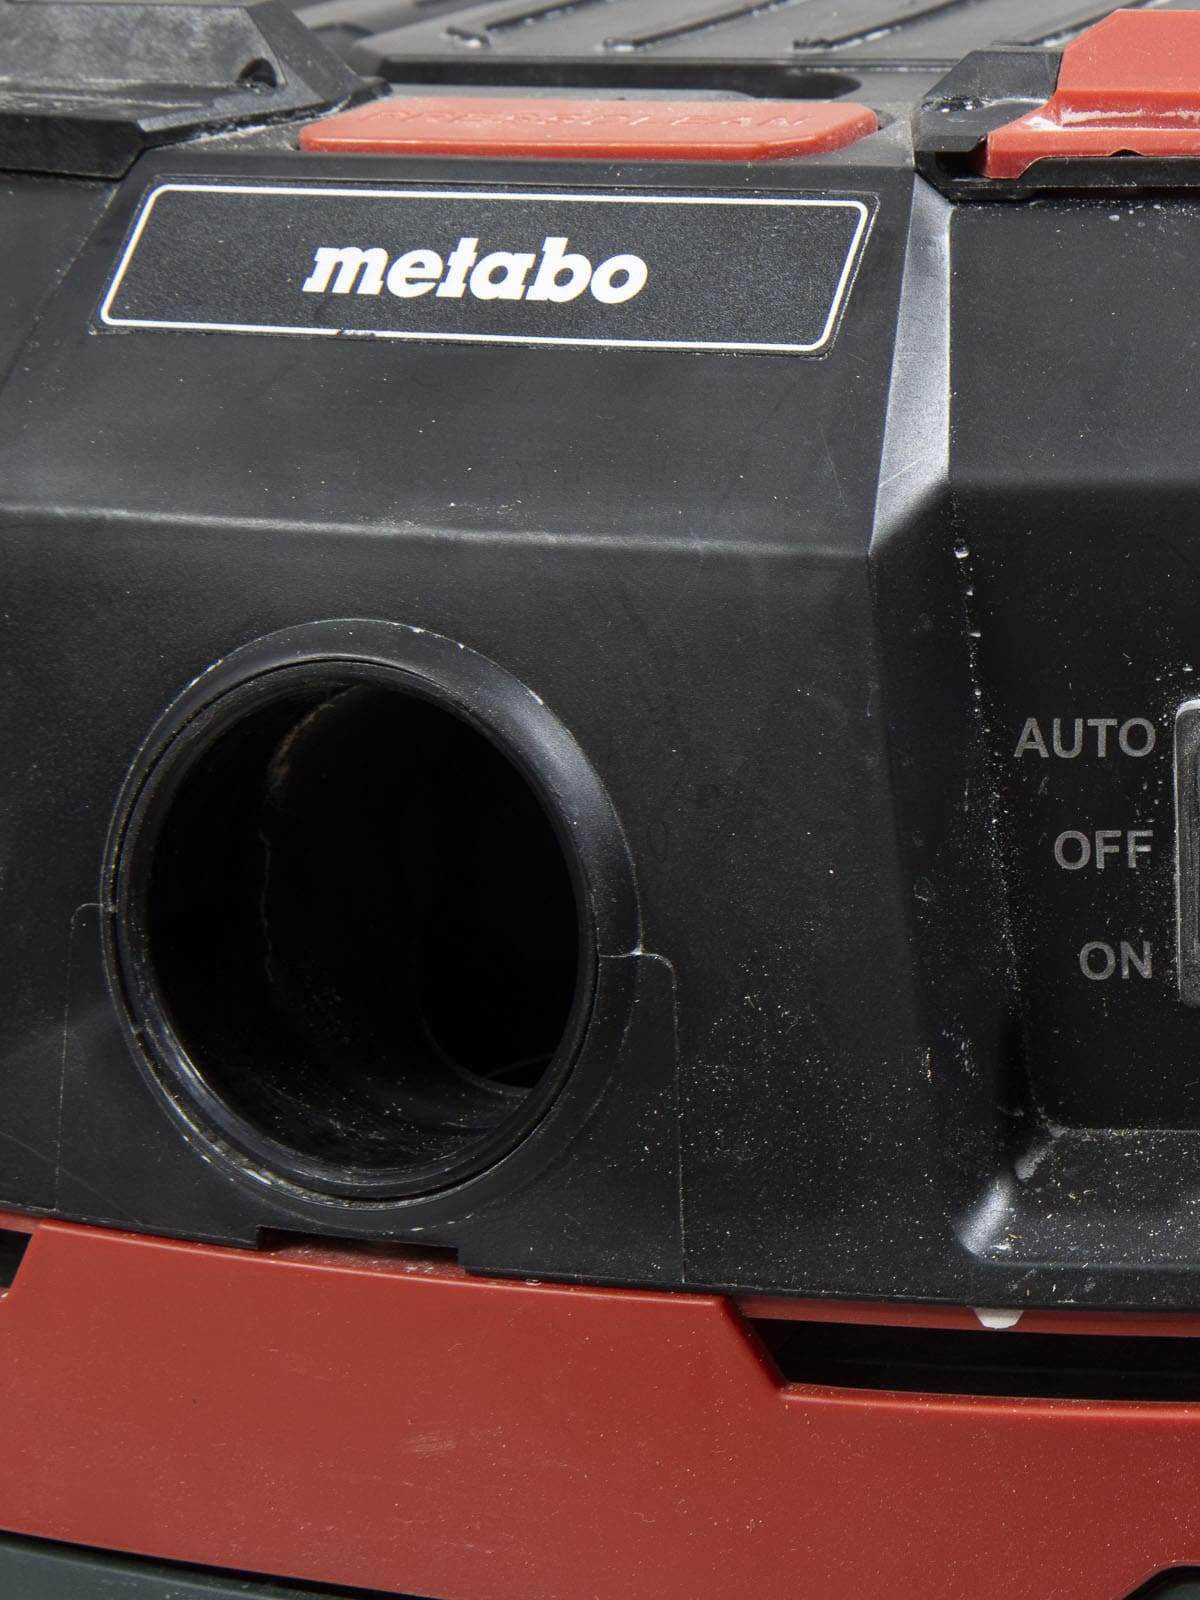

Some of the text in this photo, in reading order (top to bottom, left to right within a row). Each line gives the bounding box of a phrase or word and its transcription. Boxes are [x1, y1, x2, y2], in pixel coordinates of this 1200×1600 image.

[301, 236, 649, 304] metabo
[1013, 717, 1156, 758] AUTO
[1054, 830, 1154, 870] OFF
[1079, 940, 1153, 981] ON
